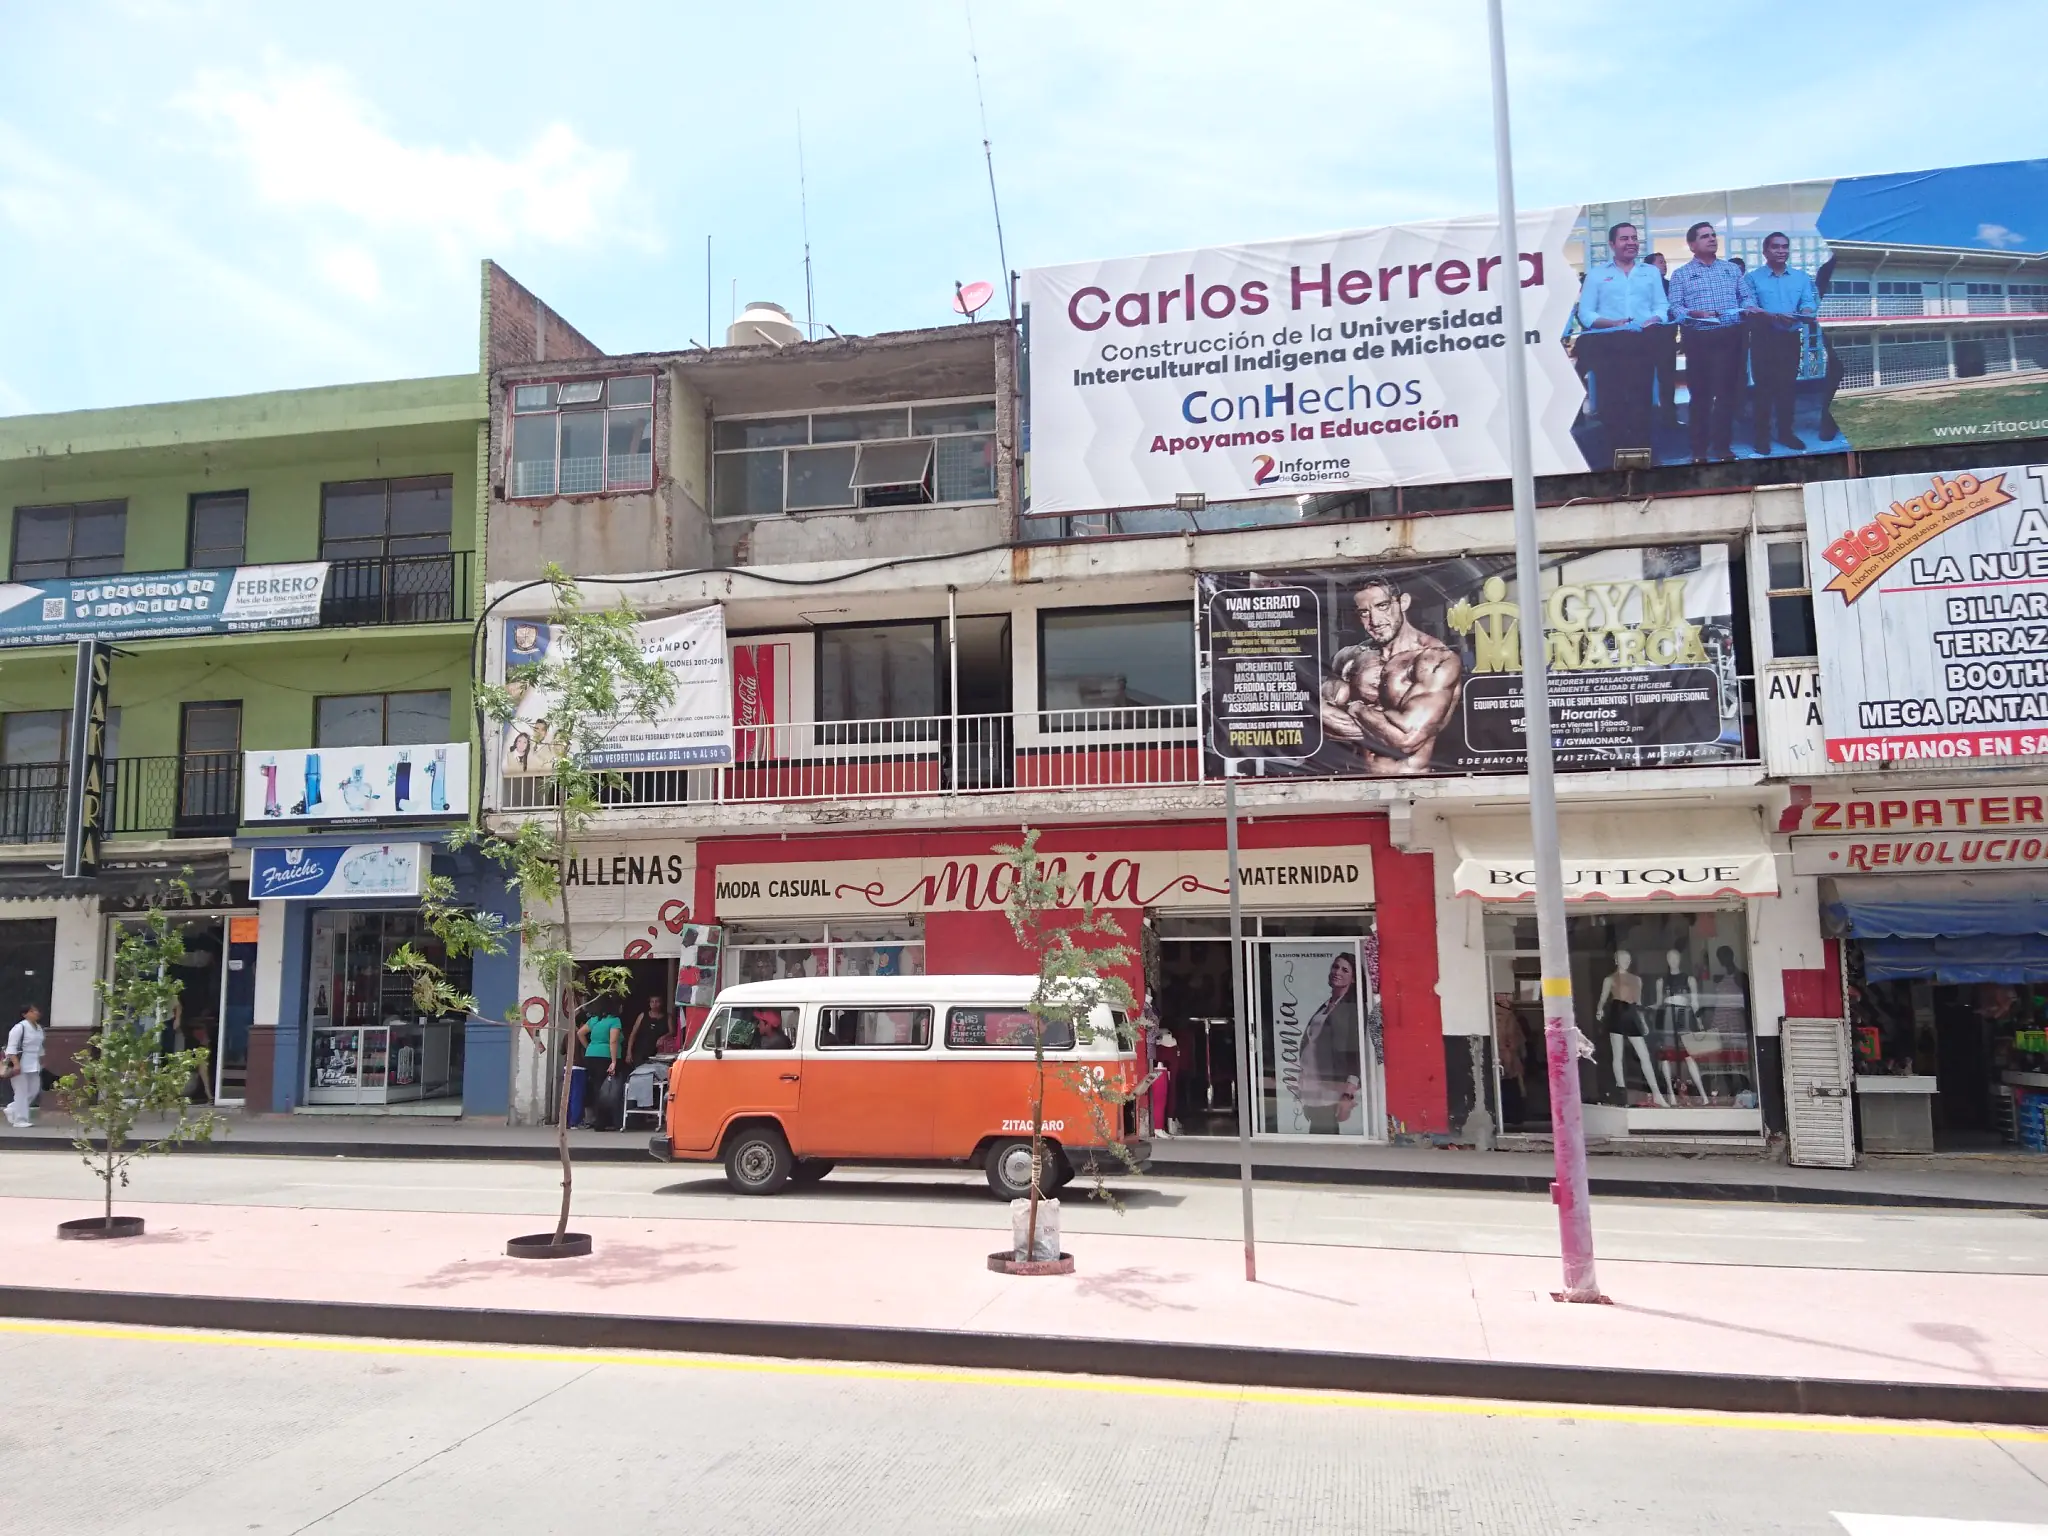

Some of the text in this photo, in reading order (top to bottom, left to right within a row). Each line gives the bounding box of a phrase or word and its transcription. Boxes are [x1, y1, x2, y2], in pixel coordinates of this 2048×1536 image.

[1068, 251, 1544, 332] Carlos Herrera
[1101, 306, 1503, 363] Construcción de la Universidad
[1073, 329, 1541, 387] Intercultural Indigena de Michoacn
[1182, 377, 1422, 425] ConHechos
[1150, 410, 1459, 455] Apoyamos la Educación
[1280, 457, 1351, 474] Informe
[1291, 470, 1350, 482] Gobierno
[1821, 472, 1983, 577] Big Nacho
[1851, 562, 1880, 588] Nachos
[1878, 522, 1939, 564] Hamburguesas
[1941, 505, 1965, 524] Alitas
[1911, 556, 1964, 585] LA
[236, 577, 319, 595] FEBRERO
[1226, 595, 1300, 611] IVAN SERRATO
[1548, 577, 1687, 631] GYM
[694, 657, 724, 666] 2017-2018
[1236, 661, 1294, 672] INCREMENTO DE
[1234, 672, 1296, 682] MASA MUSCULAR
[1547, 675, 1649, 686] MEJORES INSTALACIONES
[1234, 682, 1297, 692] PERDIDA DE PESO
[1548, 685, 1590, 693] AMBIENTE
[1594, 683, 1629, 692] CALIDAD
[1260, 692, 1269, 702] EN
[1474, 701, 1498, 710] EQUIPO
[1499, 700, 1508, 709] DE
[1548, 698, 1565, 707] ENTA
[1566, 697, 1576, 706] DE
[1577, 695, 1627, 706] SUPLEMENTOS
[1635, 694, 1660, 703] EQUIPO
[1662, 691, 1710, 702] PROFESIONAL
[1228, 701, 1304, 712] ASESORIAS EN LINEA
[1561, 707, 1617, 721] Horarios
[1859, 698, 1944, 729] MEGA
[1230, 729, 1303, 746] PREVIA CITA
[1563, 736, 1633, 746] /GYMMONARCA
[606, 752, 645, 764] VESPERTINO
[647, 751, 667, 760] BECAS
[669, 751, 680, 760] DEL
[683, 751, 690, 759] 10
[700, 749, 708, 758] AL
[710, 749, 718, 757] 50
[1840, 737, 1971, 762] VISÍTANOS
[1978, 736, 2014, 758] EN
[81, 653, 109, 864] SAKARA
[1483, 757, 1513, 765] MAYO
[1812, 796, 2048, 830] ZAPATER
[1847, 839, 2048, 872] REVOLUCIO
[262, 858, 320, 889] Fraiche
[716, 851, 1360, 911] MODA CASUAL mania MATERNIDAD
[1002, 1119, 1065, 1131] ZITACARO
